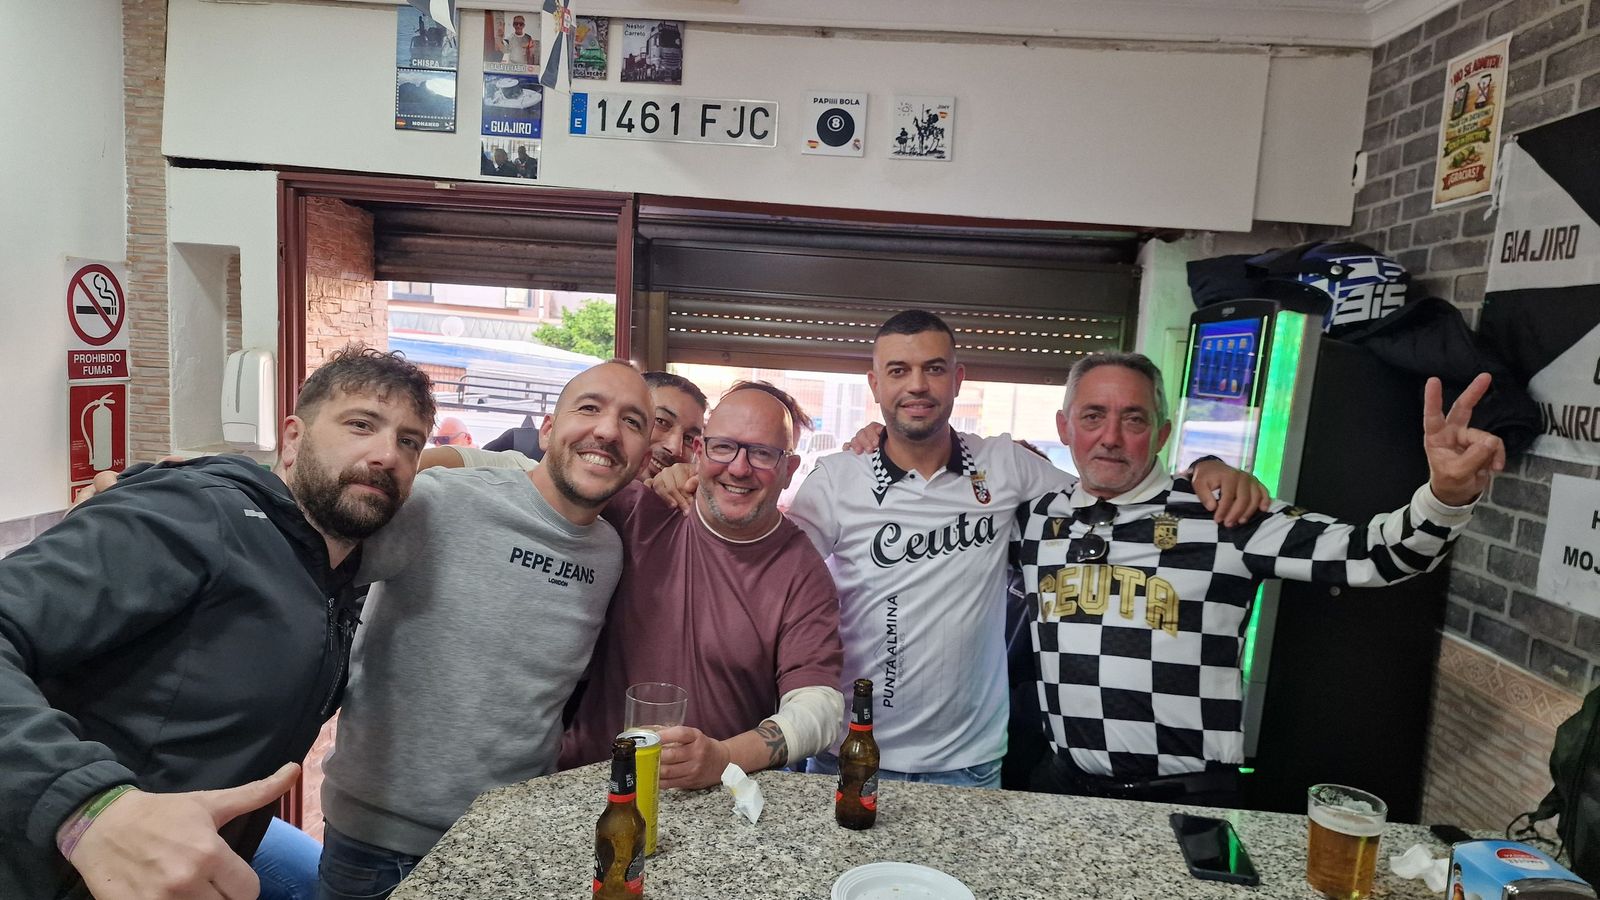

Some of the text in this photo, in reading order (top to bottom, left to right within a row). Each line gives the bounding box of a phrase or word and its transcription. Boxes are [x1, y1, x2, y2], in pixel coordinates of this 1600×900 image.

[412, 58, 440, 67] CHISPA
[839, 98, 860, 106] BOLA
[597, 99, 681, 135] 1461
[700, 103, 770, 140] FJC
[831, 117, 841, 128] 8
[490, 120, 532, 135] GUAJIRO
[73, 352, 121, 364] PROHIBIDO
[82, 364, 113, 376] FUMAR
[870, 512, 998, 568] Ceuta
[509, 546, 595, 585] PEPE JEANS
[548, 577, 569, 588] LONDON
[1038, 564, 1181, 638] CEUTA
[882, 594, 898, 709] PUNTA ALMINA
